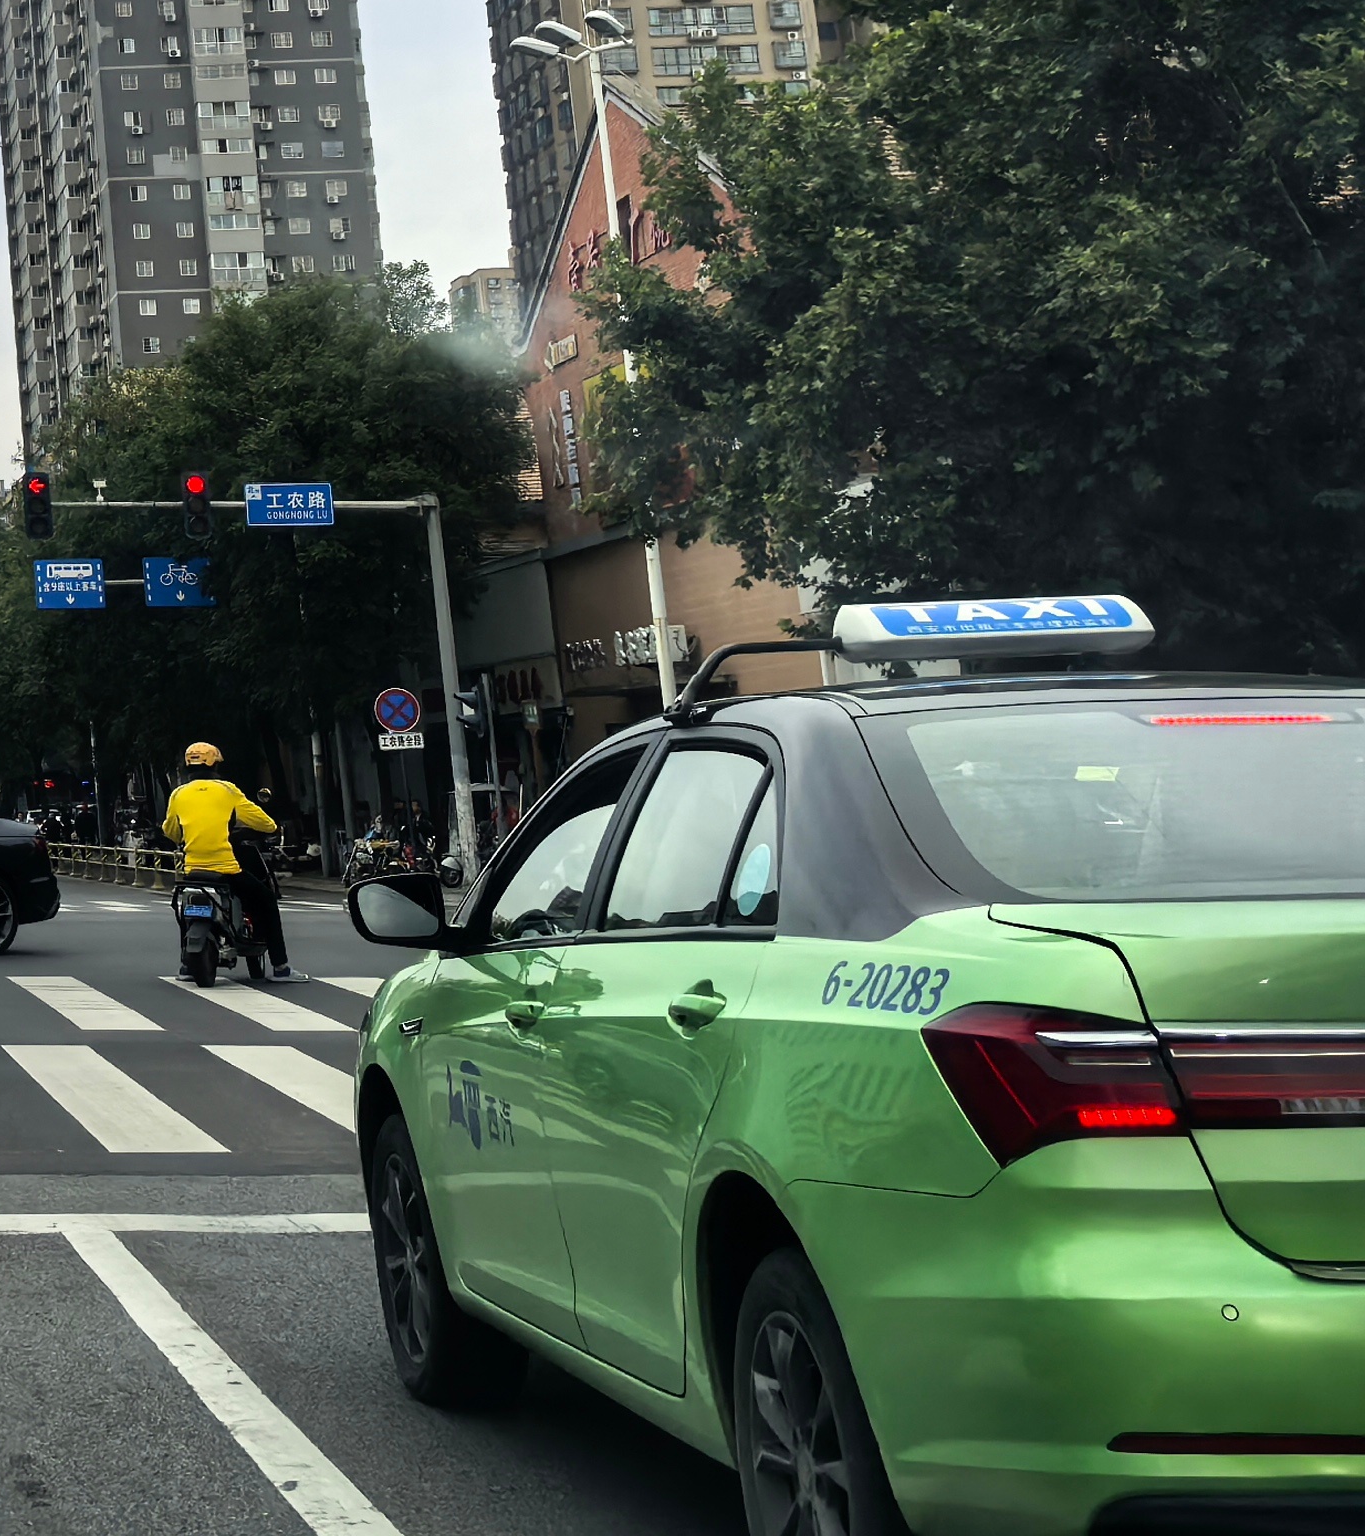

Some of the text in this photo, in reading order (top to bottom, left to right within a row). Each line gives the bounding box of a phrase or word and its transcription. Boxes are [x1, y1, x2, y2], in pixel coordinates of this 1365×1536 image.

[266, 490, 326, 509] 工农路
[266, 510, 315, 520] GONGNONG
[891, 597, 1110, 623] TAXI
[821, 960, 950, 1015] 6-20283
